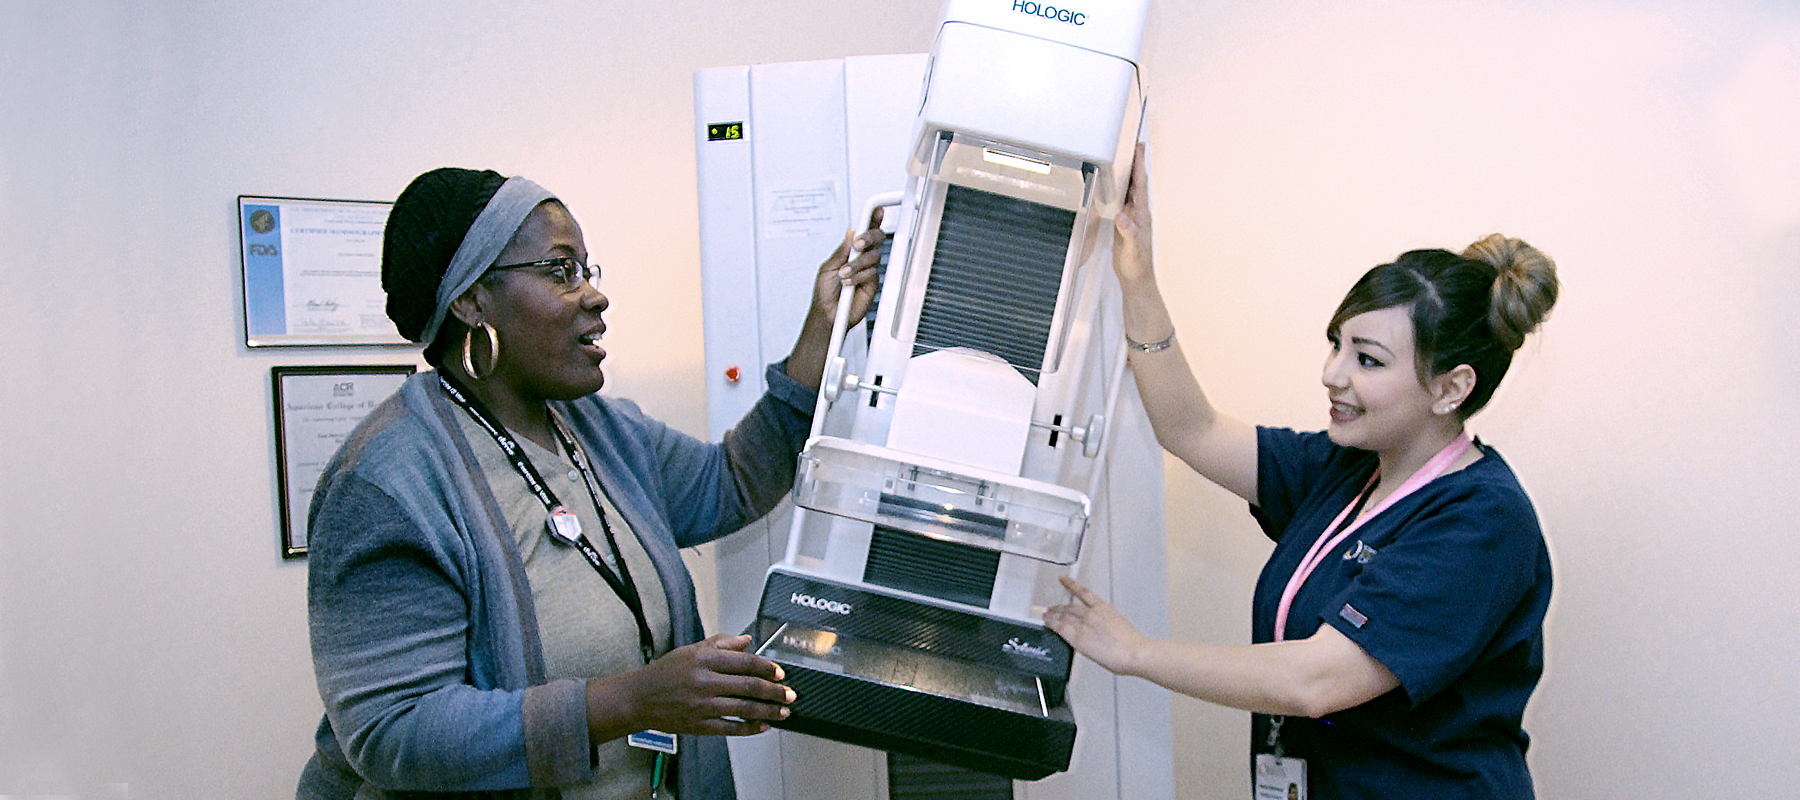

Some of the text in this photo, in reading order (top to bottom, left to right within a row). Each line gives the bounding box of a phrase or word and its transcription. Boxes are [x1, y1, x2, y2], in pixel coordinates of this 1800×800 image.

[1012, 0, 1086, 26] HOLOGIC
[248, 243, 278, 256] FDA
[790, 592, 852, 615] HOLOGIC
